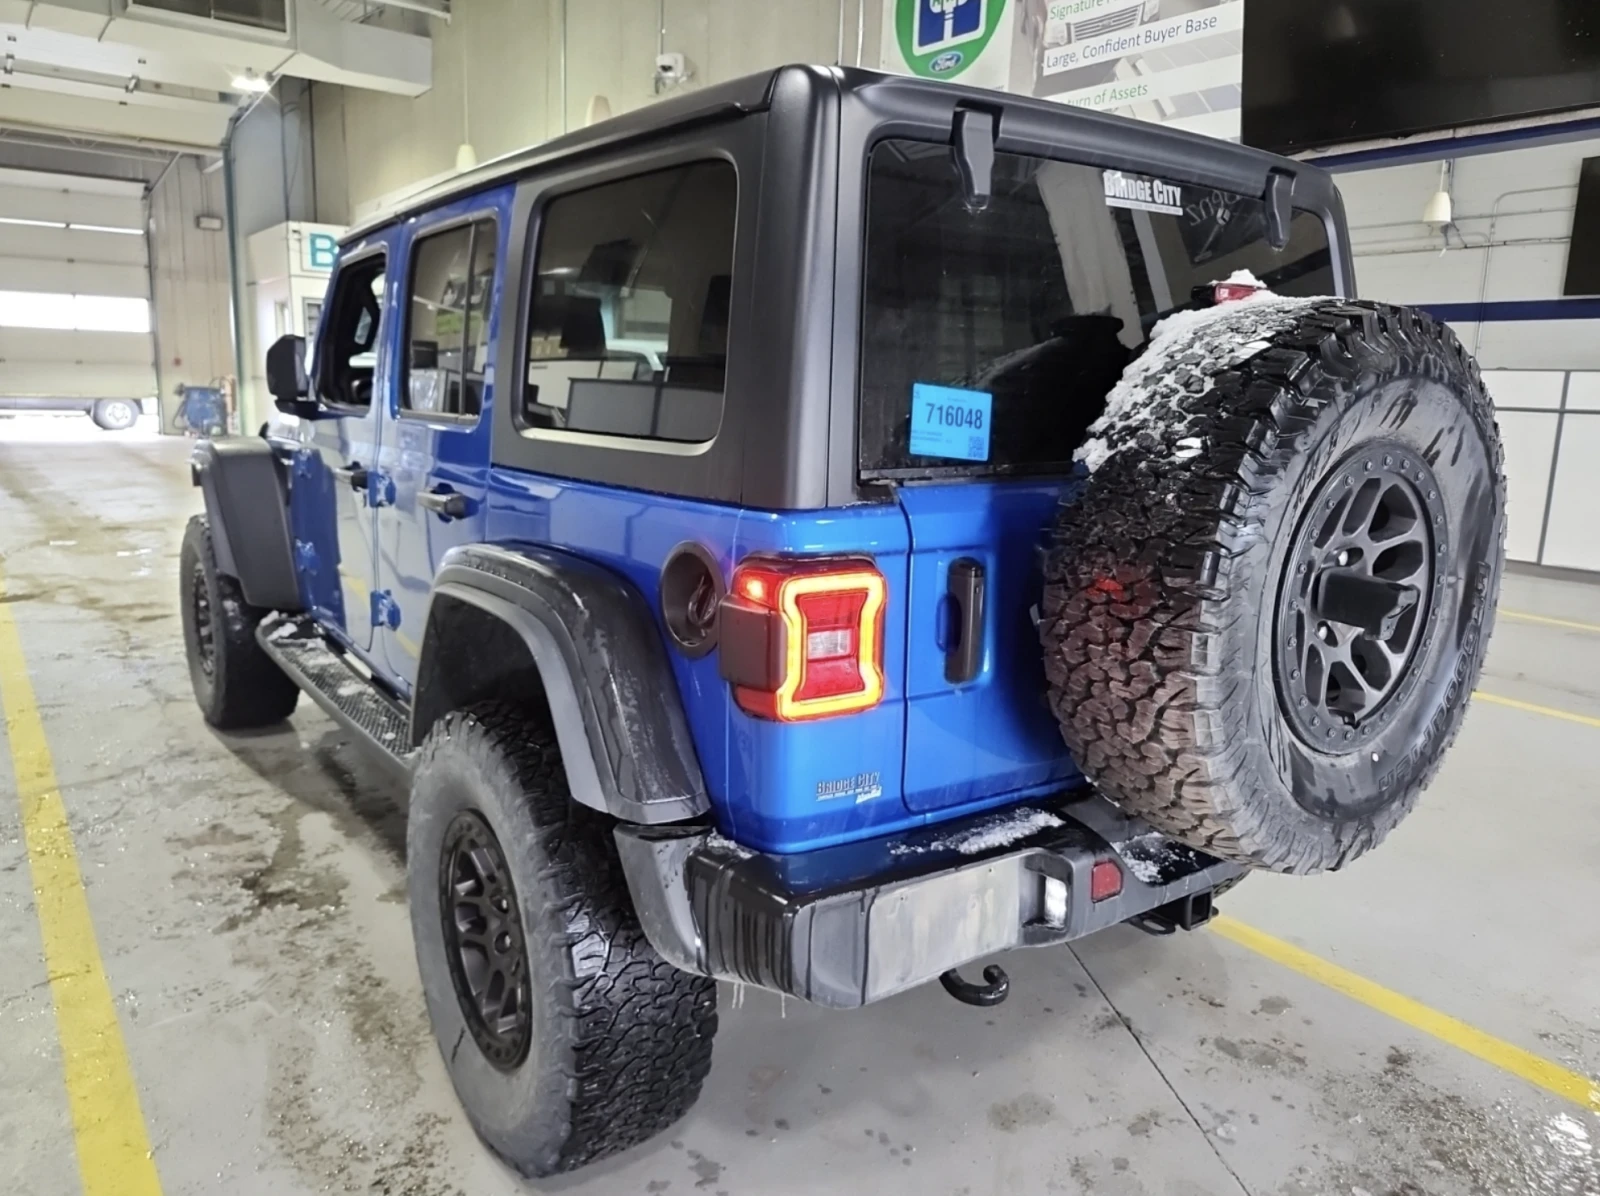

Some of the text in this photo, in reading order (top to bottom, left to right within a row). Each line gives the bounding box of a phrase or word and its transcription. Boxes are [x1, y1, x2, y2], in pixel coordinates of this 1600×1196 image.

[1050, 0, 1102, 20] Signature
[1046, 16, 1217, 69] Large, Confident Buyer Base
[1094, 90, 1107, 105] of
[1109, 83, 1149, 102] Assets
[1152, 179, 1181, 206] CITY
[926, 402, 983, 430] 716048
[817, 777, 855, 795] BRIDGE
[857, 772, 880, 788] CITY
